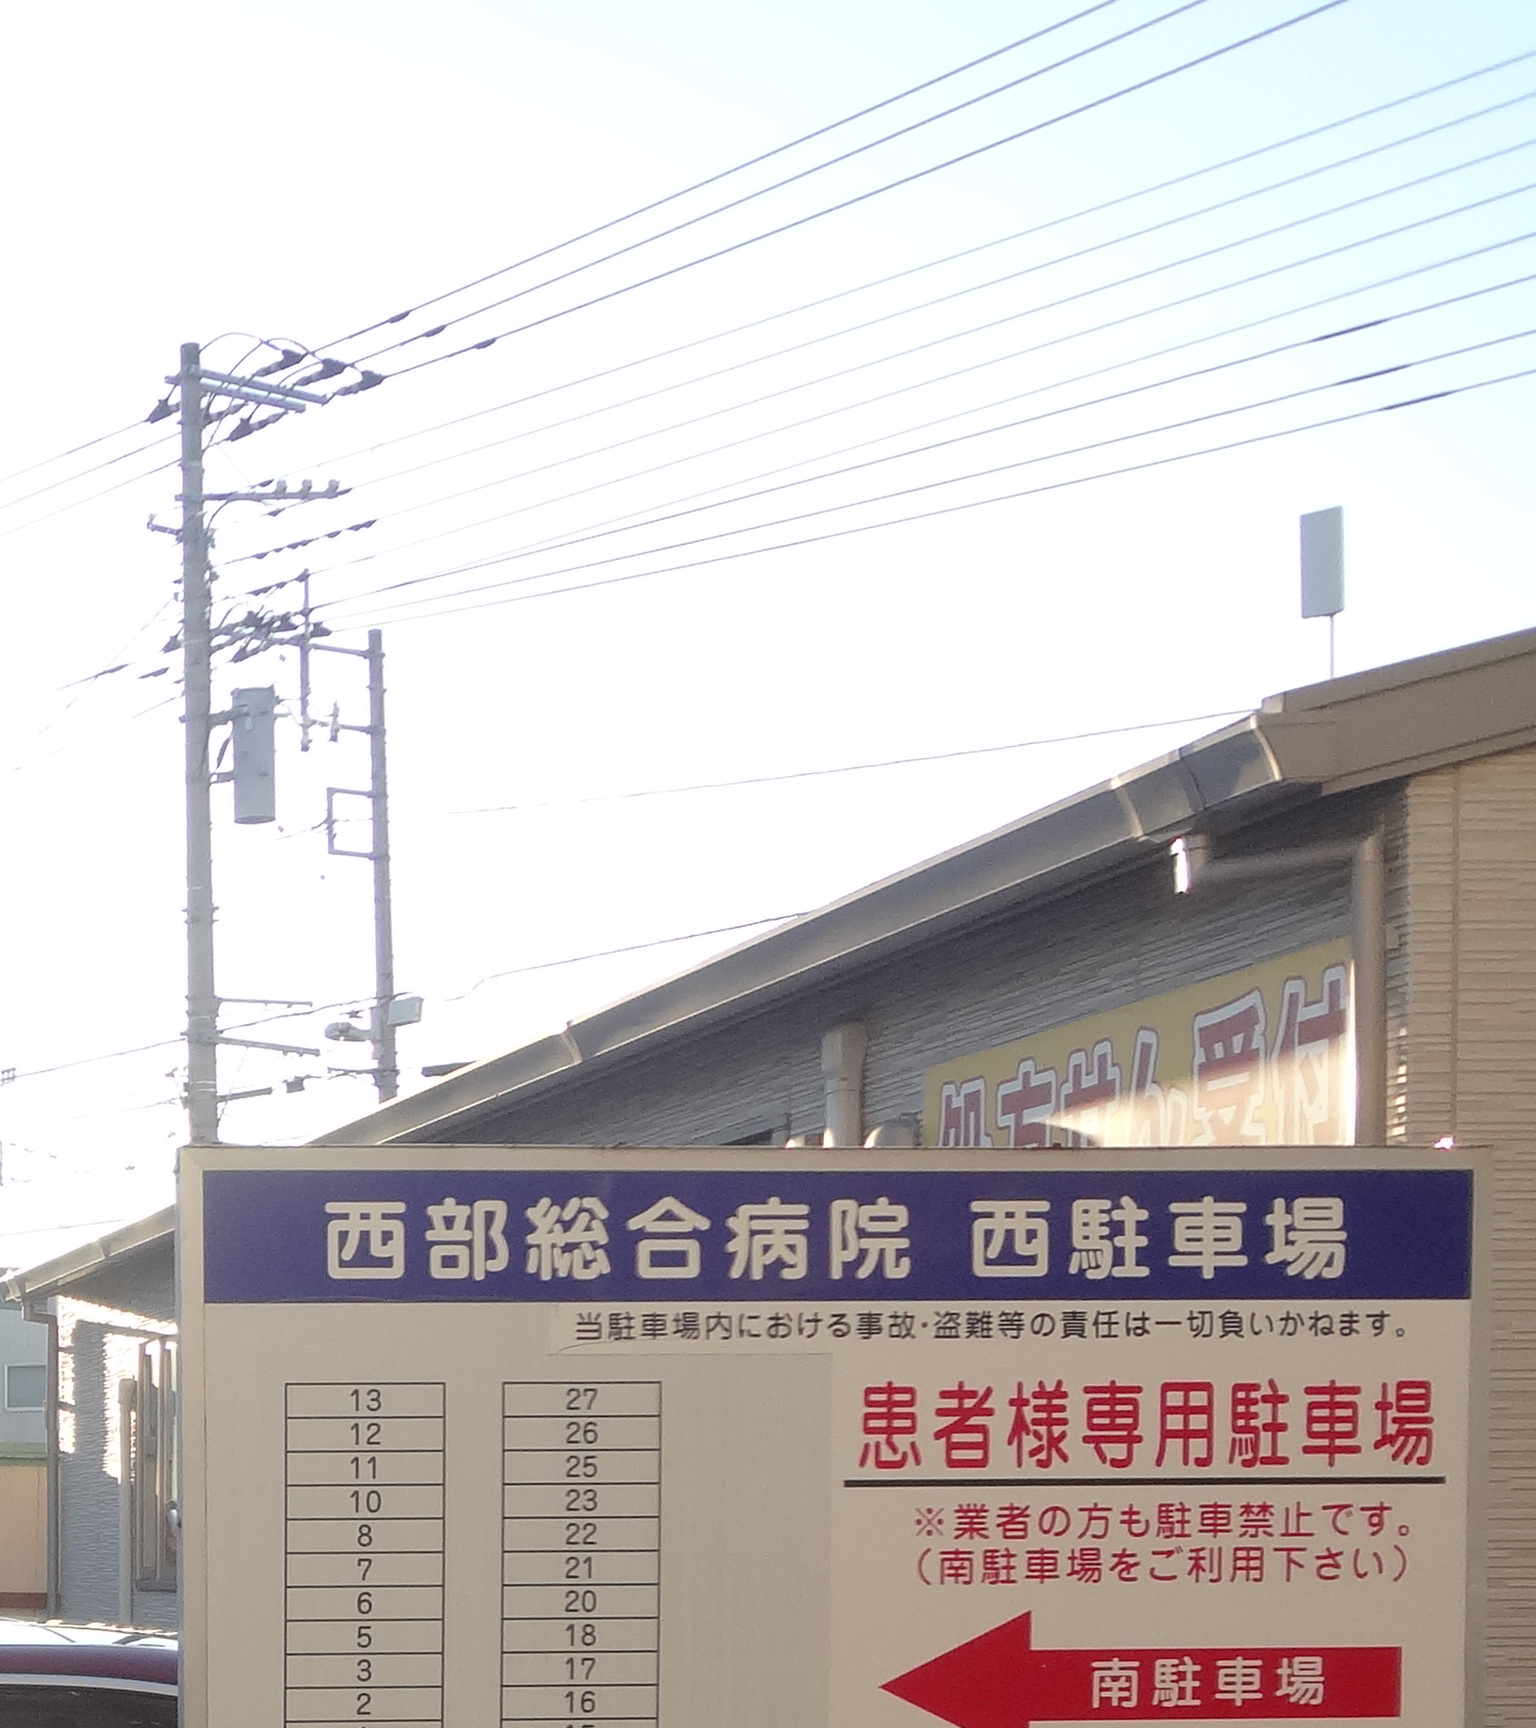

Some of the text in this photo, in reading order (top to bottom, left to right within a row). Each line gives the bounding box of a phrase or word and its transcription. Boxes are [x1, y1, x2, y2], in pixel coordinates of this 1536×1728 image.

[324, 1195, 1349, 1282] 西部総合病院 西駐車場
[350, 1388, 382, 1412] 13
[566, 1387, 598, 1411] 27
[350, 1422, 381, 1446] 12
[566, 1421, 598, 1445] 26
[858, 1379, 1436, 1470] 患者様専用駐車場
[350, 1456, 377, 1480] 11
[566, 1455, 598, 1478] 25
[350, 1489, 382, 1514] 10
[565, 1488, 598, 1512] 23
[914, 1500, 1412, 1541] ※業者の方も駐車禁止です。
[357, 1524, 373, 1548] 8
[565, 1522, 597, 1546] 22
[357, 1558, 373, 1581] 7
[565, 1556, 592, 1579] 21
[916, 1544, 1410, 1586] （南駐車場をご利用下さい）
[357, 1591, 373, 1615] 6
[564, 1589, 597, 1613] 20
[357, 1625, 372, 1649] 5
[566, 1623, 597, 1647] 18
[356, 1658, 372, 1683] 3
[565, 1657, 596, 1680] 17
[1090, 1654, 1327, 1709] 南駐車場
[356, 1692, 372, 1716] 2
[565, 1690, 596, 1714] 16
